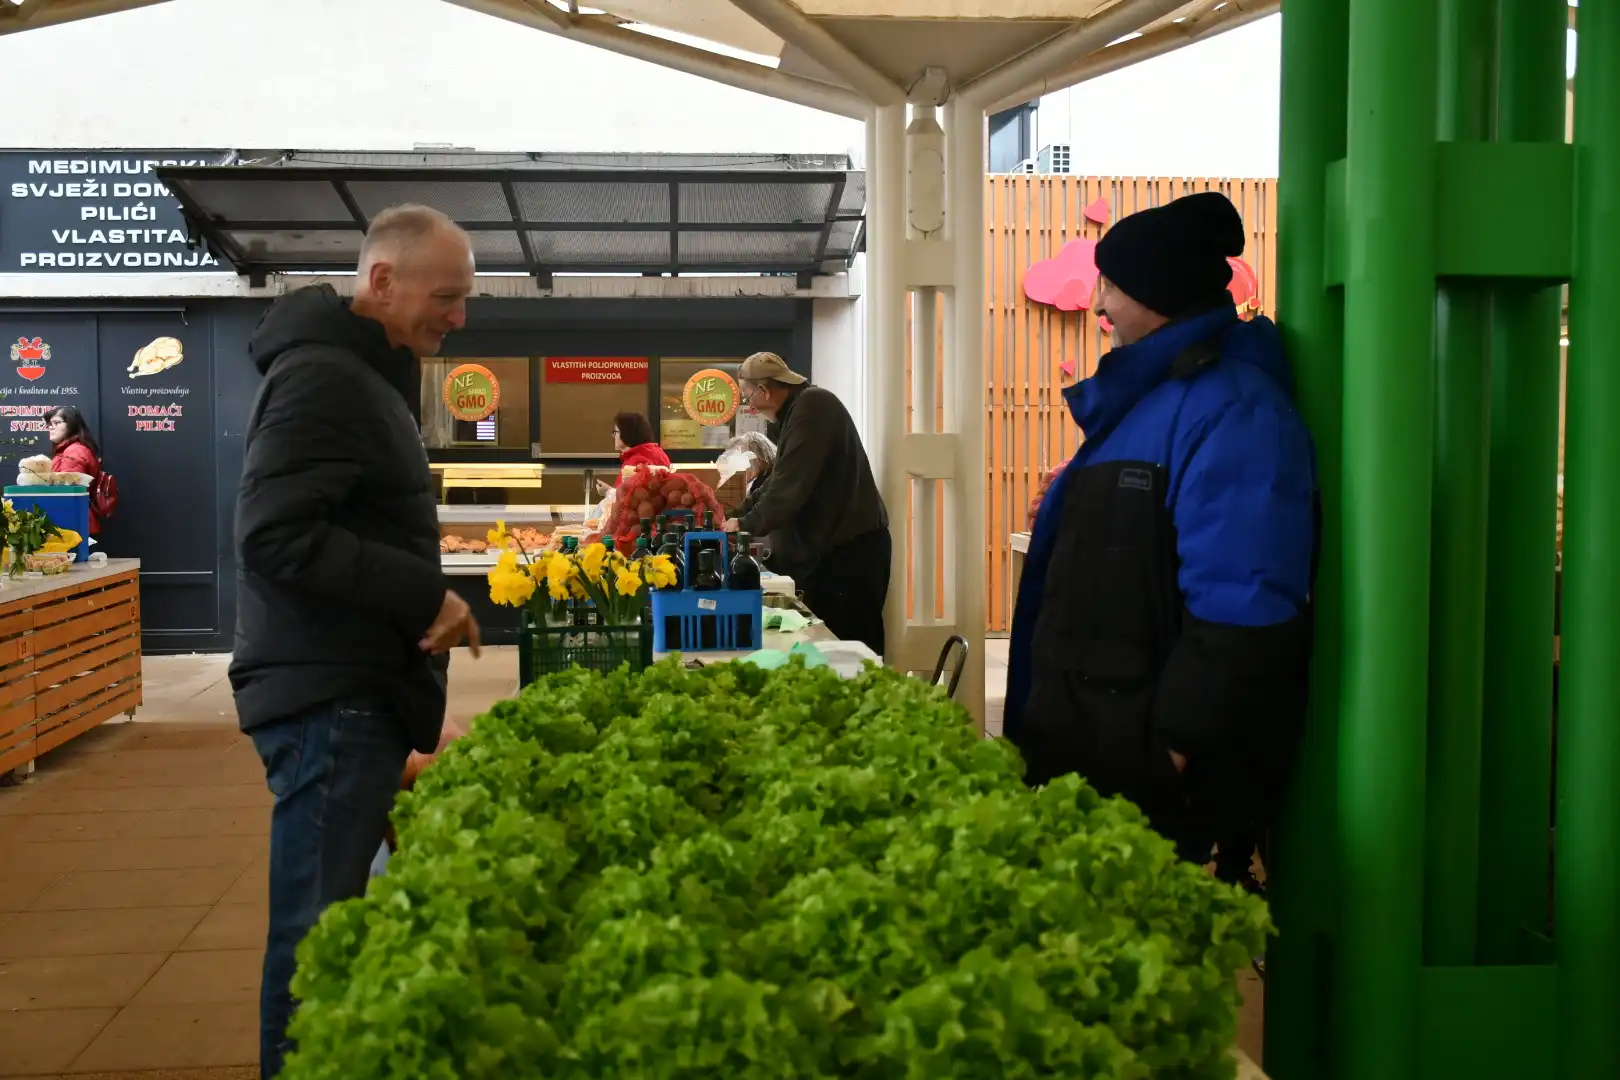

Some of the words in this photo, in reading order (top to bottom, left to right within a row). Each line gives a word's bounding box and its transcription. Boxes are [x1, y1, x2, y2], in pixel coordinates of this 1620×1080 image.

[11, 178, 107, 198] SVJEŽI
[113, 183, 175, 197] DOM
[80, 201, 157, 221] PILIĆI
[51, 229, 188, 244] VLASTITA
[20, 252, 219, 267] PROIZVODNJA
[552, 361, 587, 369] VLASTITIH
[454, 373, 475, 390] NE
[581, 372, 622, 380] PROIZVODA
[19, 385, 49, 395] kvaliteta
[49, 385, 61, 395] od
[61, 386, 80, 395] 1955.
[120, 385, 149, 395] Vlastita
[147, 385, 190, 398] proizvodnja
[695, 378, 716, 394] NE
[128, 402, 182, 416] DOMAĆI
[456, 395, 486, 409] GMO
[696, 400, 726, 413] GMO
[10, 418, 50, 431] SVJEŽ
[136, 418, 175, 431] PILIĆI
